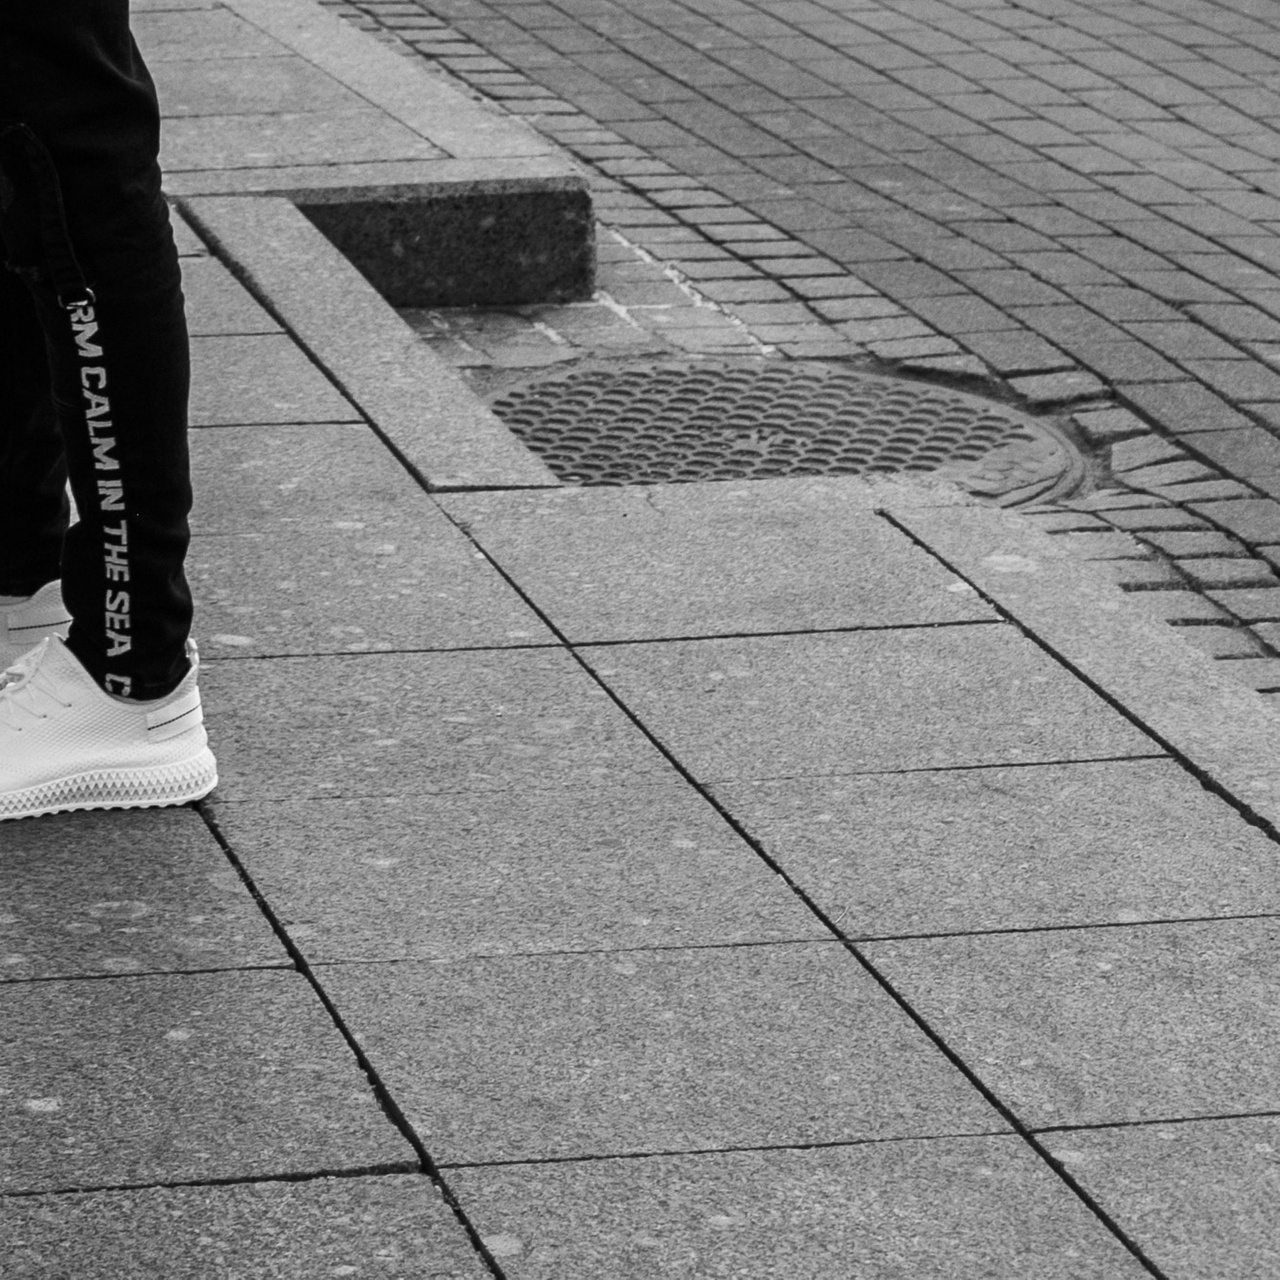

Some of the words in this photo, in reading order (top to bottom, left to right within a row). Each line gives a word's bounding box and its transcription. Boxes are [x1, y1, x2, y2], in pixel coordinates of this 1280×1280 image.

[80, 366, 120, 471] CALM
[96, 479, 126, 511] IN
[103, 519, 130, 582] THE
[104, 589, 132, 657] SEA
